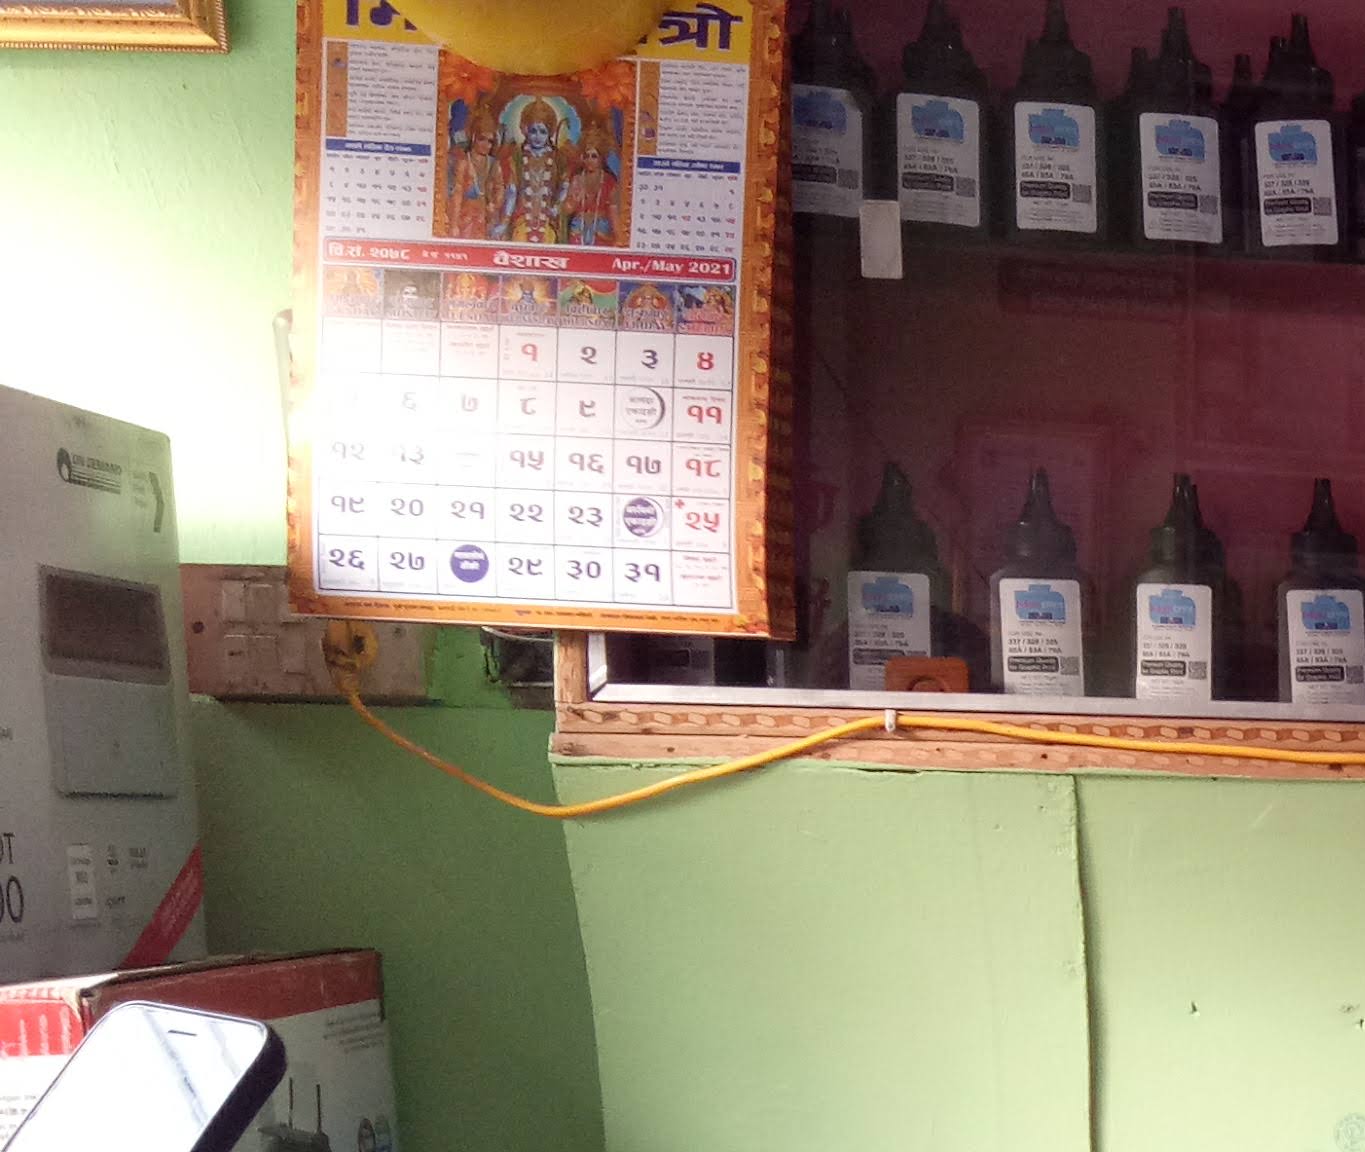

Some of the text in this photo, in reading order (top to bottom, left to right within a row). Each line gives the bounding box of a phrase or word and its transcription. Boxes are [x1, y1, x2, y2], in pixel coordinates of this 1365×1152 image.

[688, 261, 731, 275] 2021
[521, 343, 714, 370] १ २ ३ ४
[461, 394, 479, 412] ७
[520, 397, 536, 415] ८
[578, 399, 596, 417] ९
[687, 404, 723, 424] ११
[509, 449, 722, 478] १५ १६ १७ १८
[331, 495, 721, 533] १९ २० २१ २२ २३ २५
[329, 548, 661, 583] २६ २७ २९ ३० ३१
